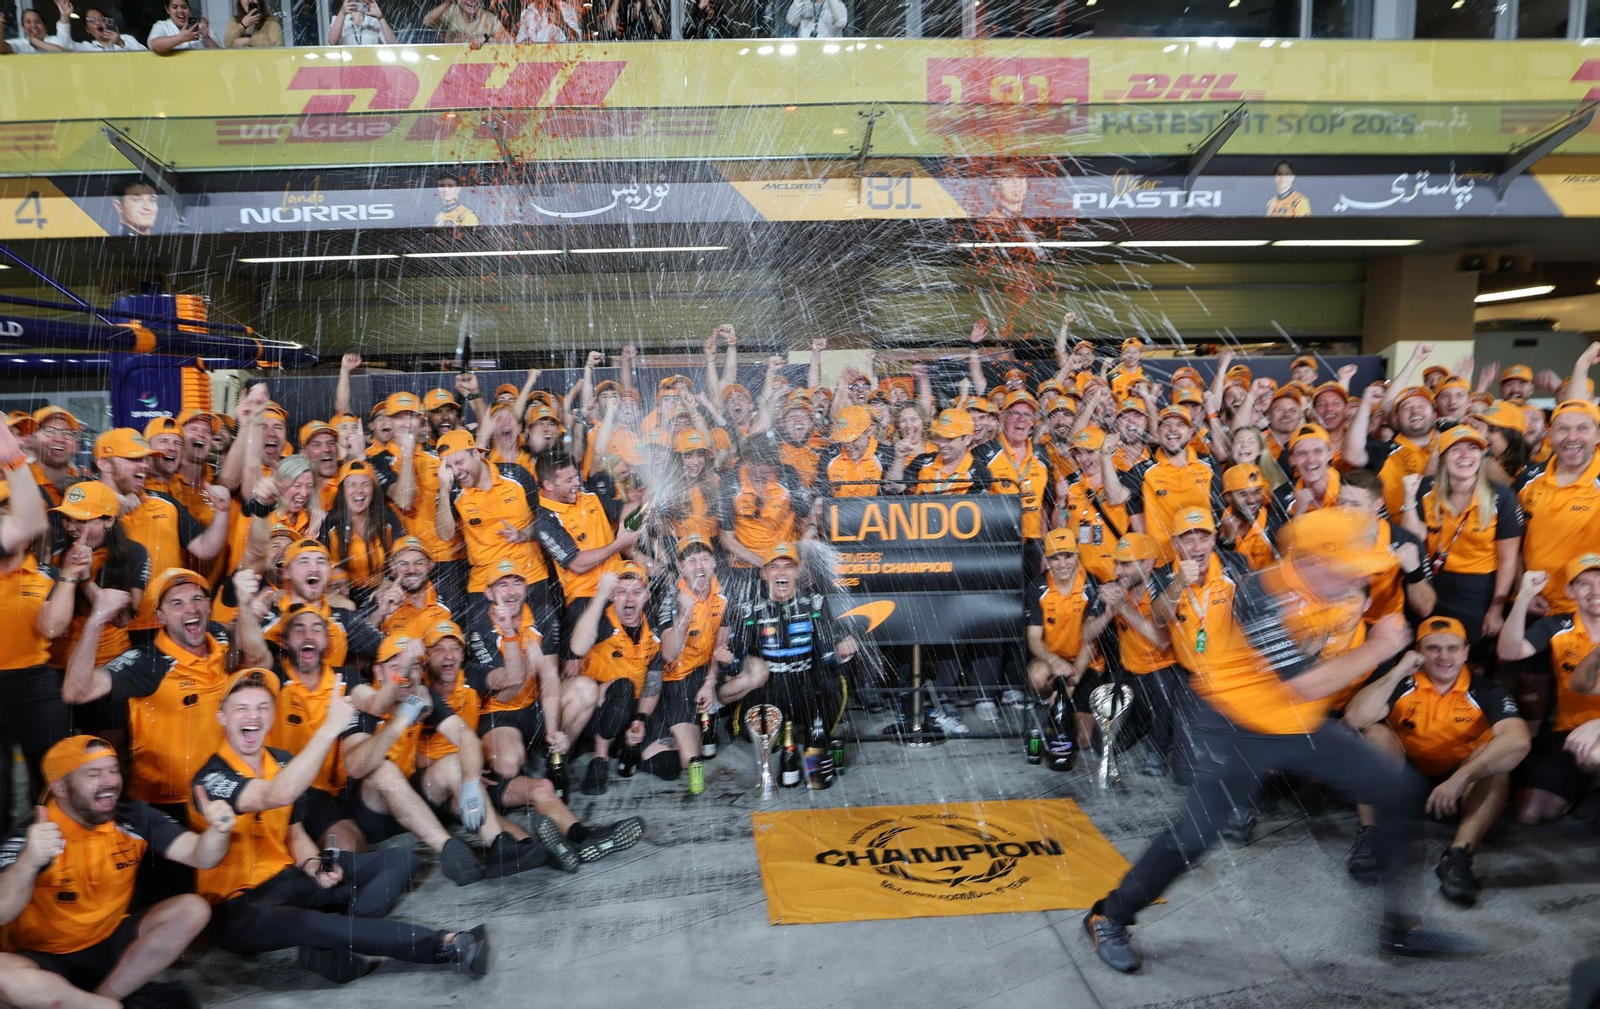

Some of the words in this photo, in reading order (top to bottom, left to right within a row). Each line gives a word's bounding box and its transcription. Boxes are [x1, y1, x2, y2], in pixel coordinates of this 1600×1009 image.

[284, 60, 645, 144] DHL
[1127, 73, 1245, 100] DHL
[1102, 112, 1220, 134] FASTEST
[1234, 112, 1271, 134] IT
[1276, 113, 1345, 135] STOP
[1351, 113, 1417, 135] 2025
[866, 171, 922, 211] 81
[1112, 166, 1163, 197] Oscar
[14, 190, 48, 230] 4
[240, 203, 395, 225] NORRIS
[1073, 190, 1223, 210] PIASTRI
[829, 500, 982, 542] LANDO
[834, 562, 881, 574] WORLD
[881, 561, 953, 574] CHAMPION
[815, 837, 1066, 868] CHAMPION
